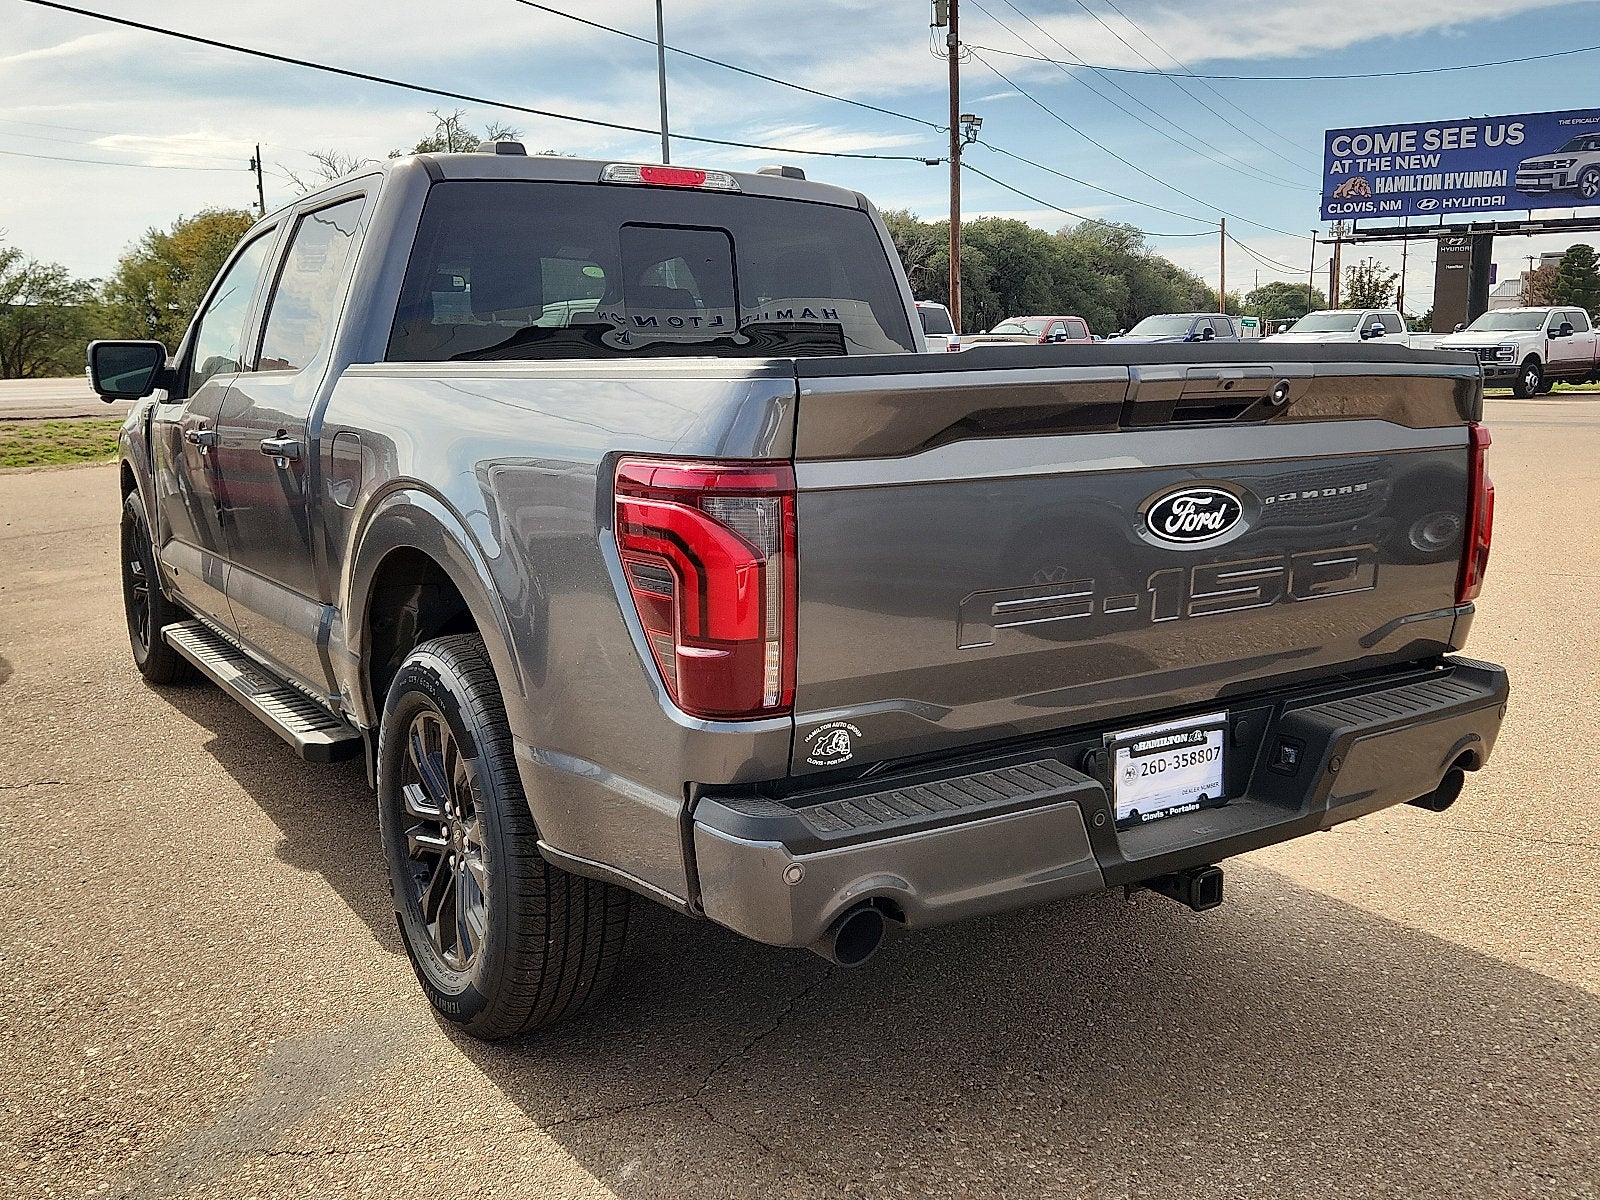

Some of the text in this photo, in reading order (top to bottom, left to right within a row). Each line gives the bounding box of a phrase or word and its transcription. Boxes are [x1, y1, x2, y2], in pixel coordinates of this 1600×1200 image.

[1331, 122, 1525, 157] COME SEE US
[1329, 153, 1441, 175] AT THE NEW
[1375, 169, 1508, 194] HAMILTON HYUNDAI
[1327, 199, 1402, 214] CLOVIS, NM
[1442, 195, 1506, 208] HYUNDAI
[1164, 496, 1226, 533] Ford
[639, 582, 672, 594] FORD
[956, 543, 1378, 650] F-150
[804, 723, 832, 743] HAMILTON
[847, 723, 863, 738] GROUP
[1138, 733, 1188, 751] HAMILTON
[1141, 745, 1221, 777] 26D-358807
[1181, 781, 1219, 796] DEALER NUMBER
[1142, 803, 1200, 822] Clovis Portales
